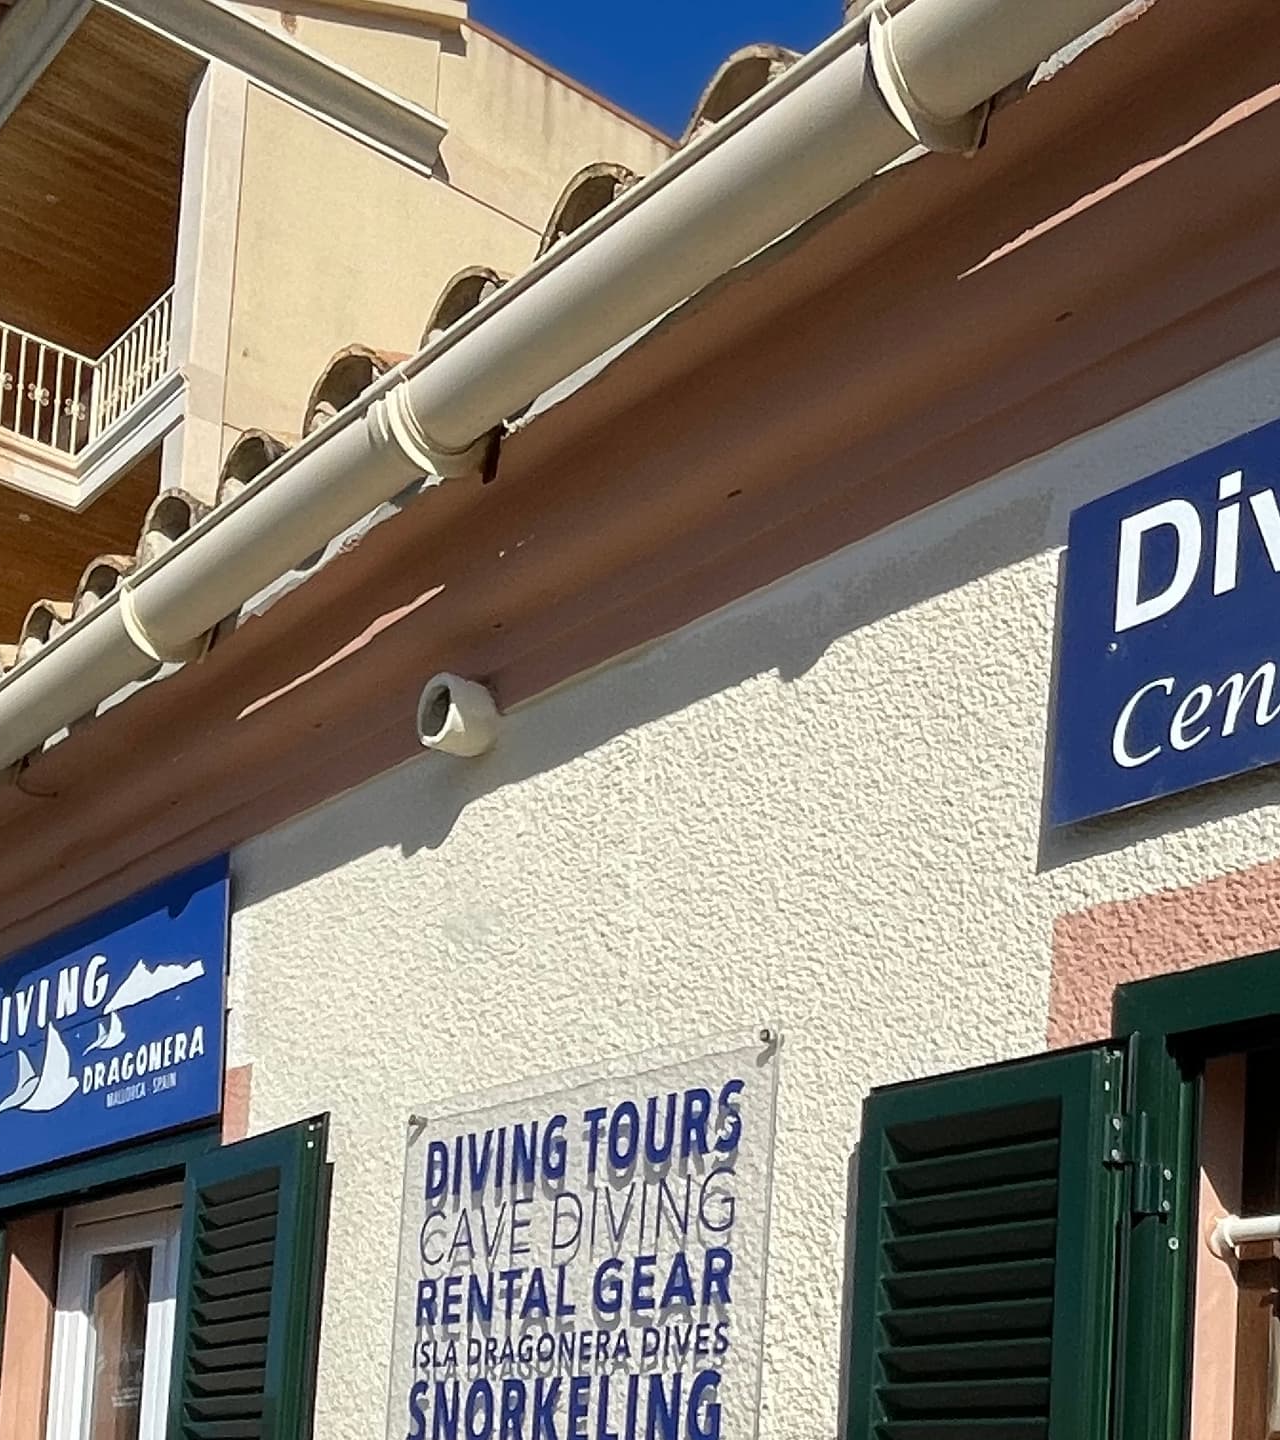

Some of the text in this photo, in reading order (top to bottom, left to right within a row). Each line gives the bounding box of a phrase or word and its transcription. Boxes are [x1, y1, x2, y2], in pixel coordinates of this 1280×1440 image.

[82, 1025, 204, 1095] DRAGONERA
[106, 1071, 177, 1108] MALLORCA SPAIN
[424, 1079, 745, 1201] DIVING TOURS
[420, 1166, 737, 1266] CAVE DIVING
[416, 1246, 733, 1327] RENTAL GEAR
[412, 1321, 731, 1368] ISLA DRAGONERA DIVES
